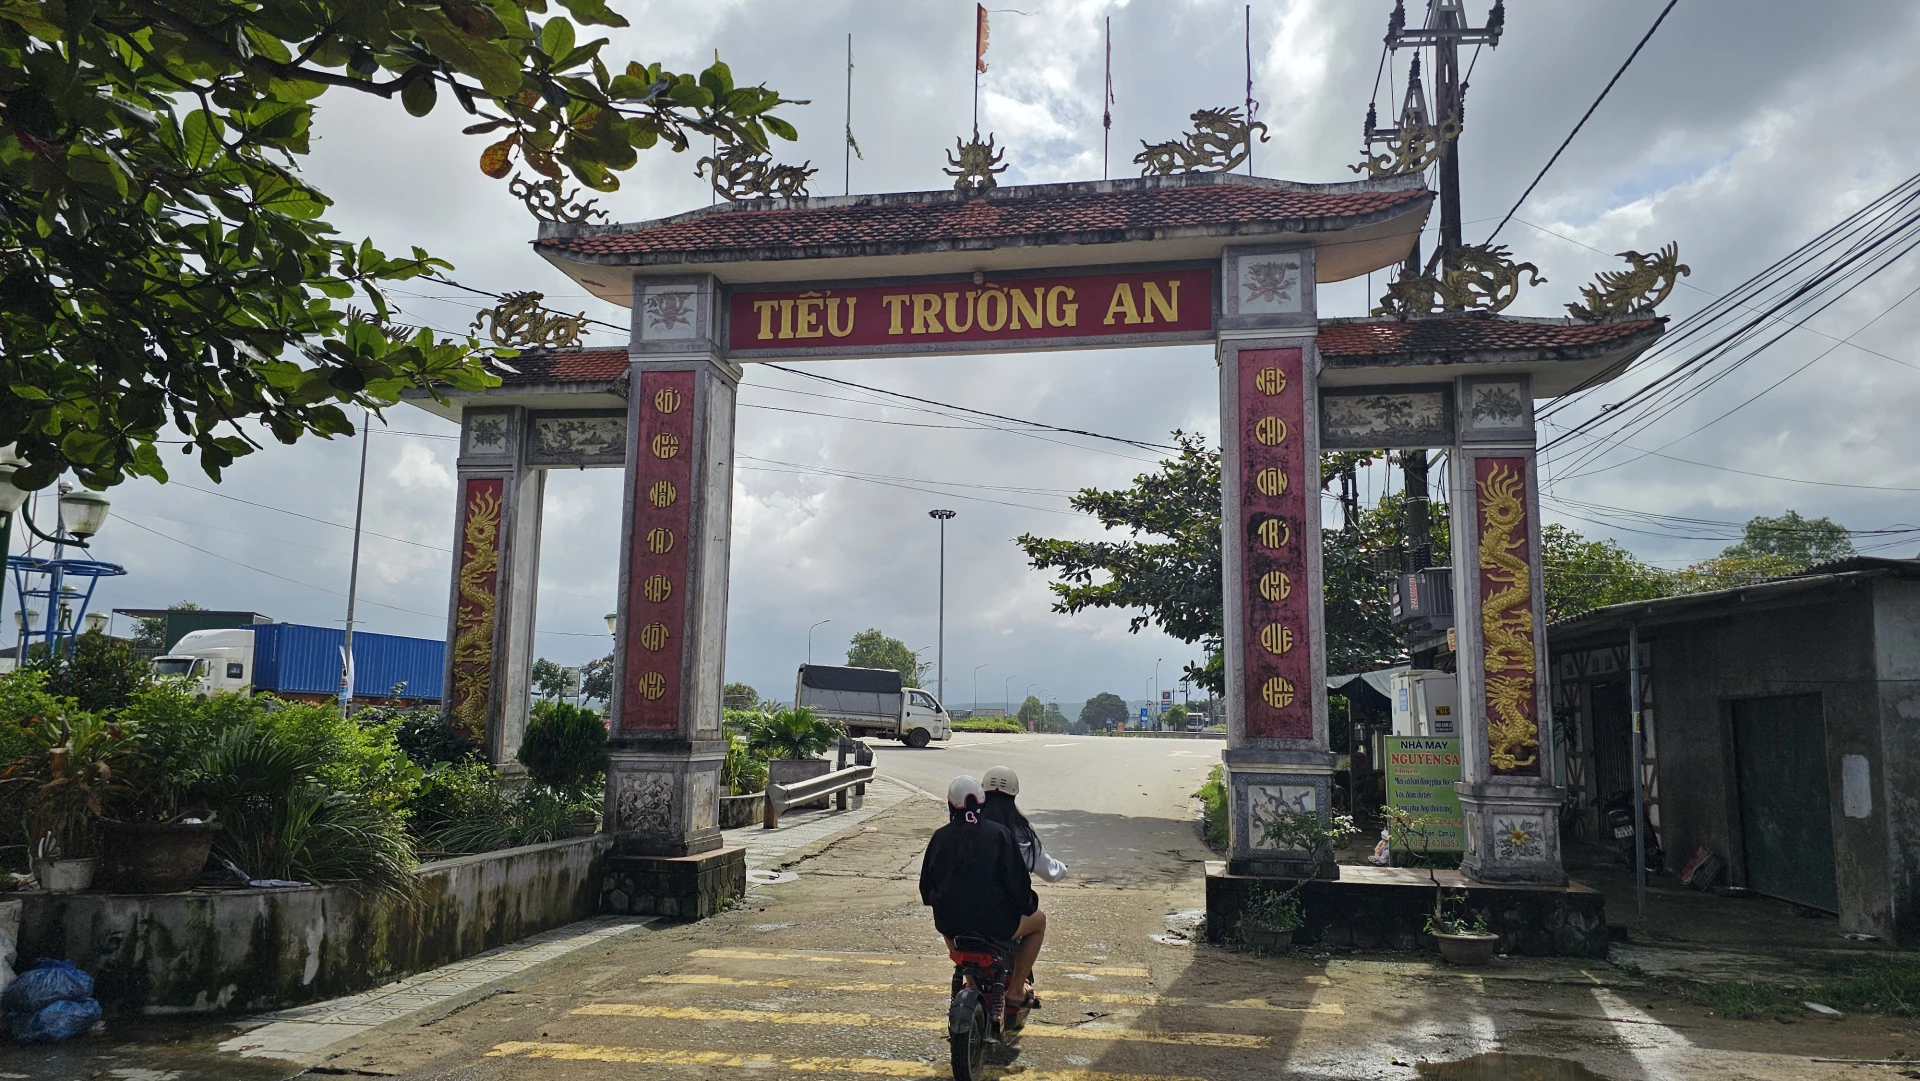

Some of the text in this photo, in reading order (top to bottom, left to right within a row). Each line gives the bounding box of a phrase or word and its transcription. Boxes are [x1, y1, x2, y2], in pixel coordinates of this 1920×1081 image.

[754, 281, 1180, 340] TIỂU TRƯỜNG AN
[1256, 367, 1287, 395] NÂNG
[1256, 416, 1287, 445] CAO
[649, 481, 677, 508] NHÂN
[1257, 467, 1288, 496] DÂN
[646, 528, 674, 554] TÀI
[644, 575, 672, 602] XÂY
[1261, 623, 1293, 654] QUÊ
[1391, 751, 1441, 765] NGUYÊN
[1401, 739, 1448, 750] NHÀ MAY
